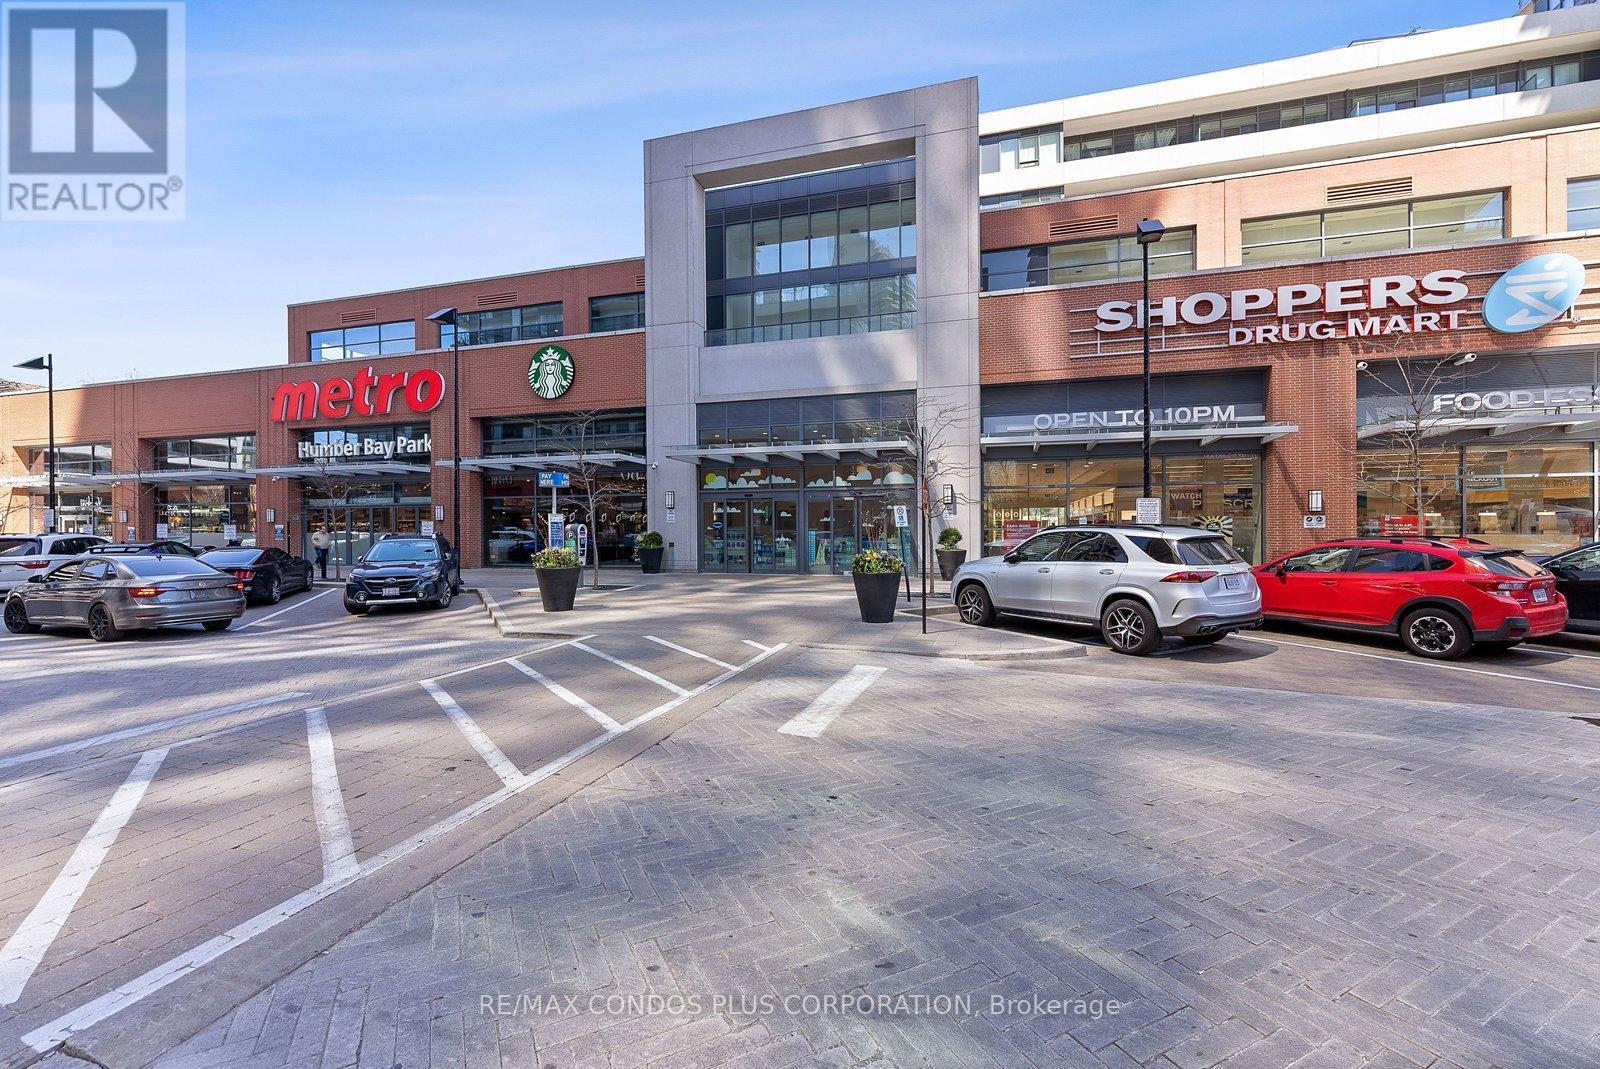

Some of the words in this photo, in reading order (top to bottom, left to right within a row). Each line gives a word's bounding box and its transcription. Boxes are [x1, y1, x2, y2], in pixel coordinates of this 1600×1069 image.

[1094, 269, 1469, 332] SHOPPERS
[1228, 319, 1336, 346] DRUG
[1346, 309, 1467, 337] MART
[271, 366, 446, 422] metro
[1433, 390, 1536, 413] FOOD
[1543, 385, 1600, 407] ES
[1033, 411, 1108, 430] OPEN
[1115, 409, 1155, 426] TO
[1164, 404, 1236, 424] 10PM
[298, 439, 362, 458] Humber
[363, 437, 396, 459] Bay
[396, 433, 432, 454] Park
[1171, 492, 1202, 500] WATCH
